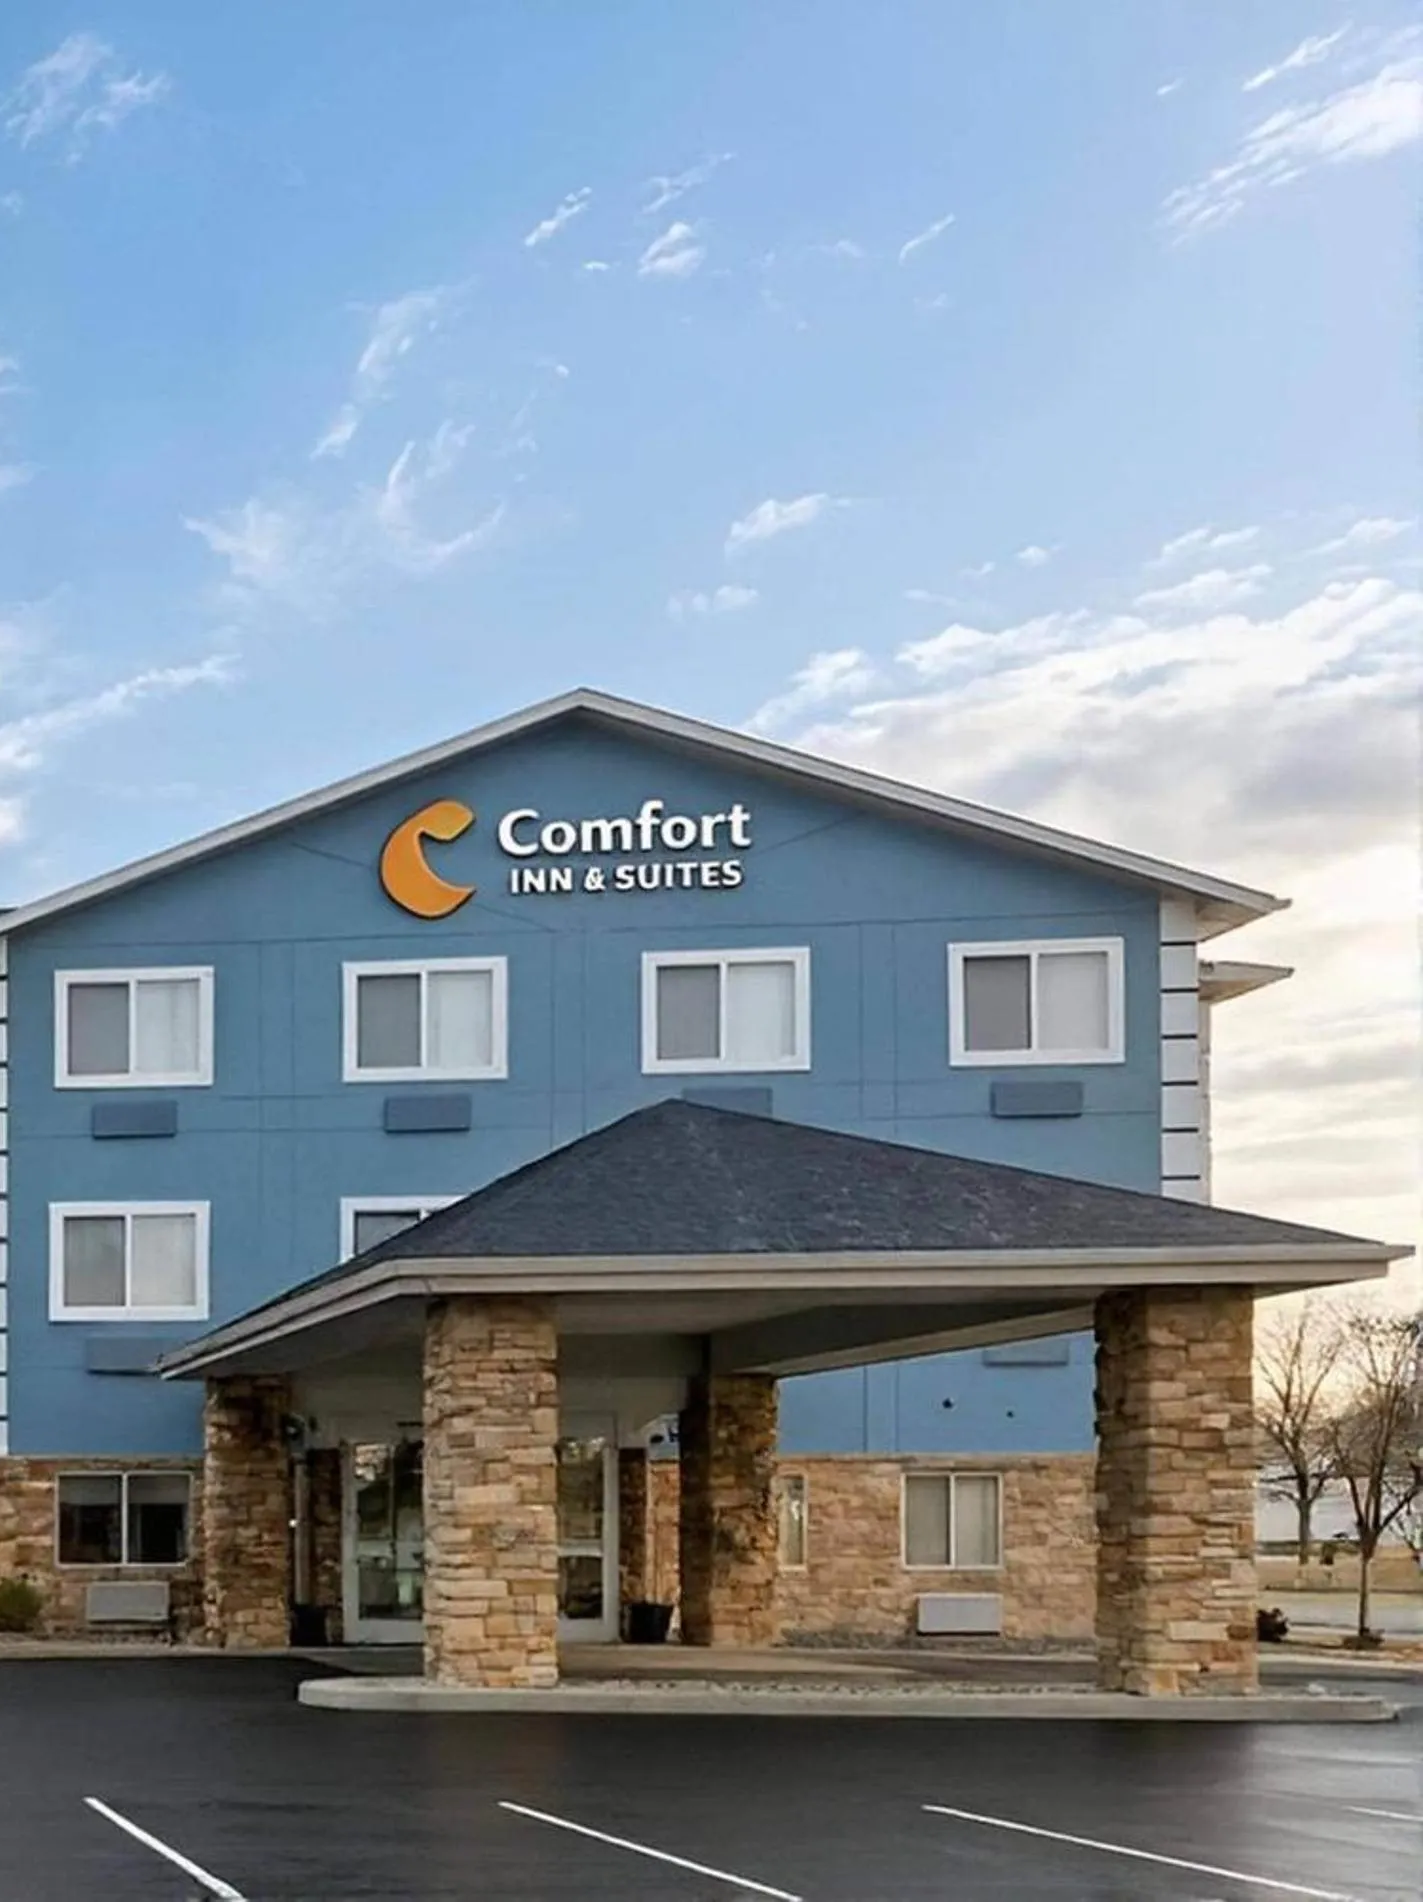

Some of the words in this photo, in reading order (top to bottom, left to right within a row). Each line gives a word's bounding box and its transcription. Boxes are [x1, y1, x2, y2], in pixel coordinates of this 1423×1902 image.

[497, 799, 752, 856] Comfort
[510, 866, 573, 894] INN
[583, 865, 607, 891] &
[614, 859, 743, 891] SUITES
